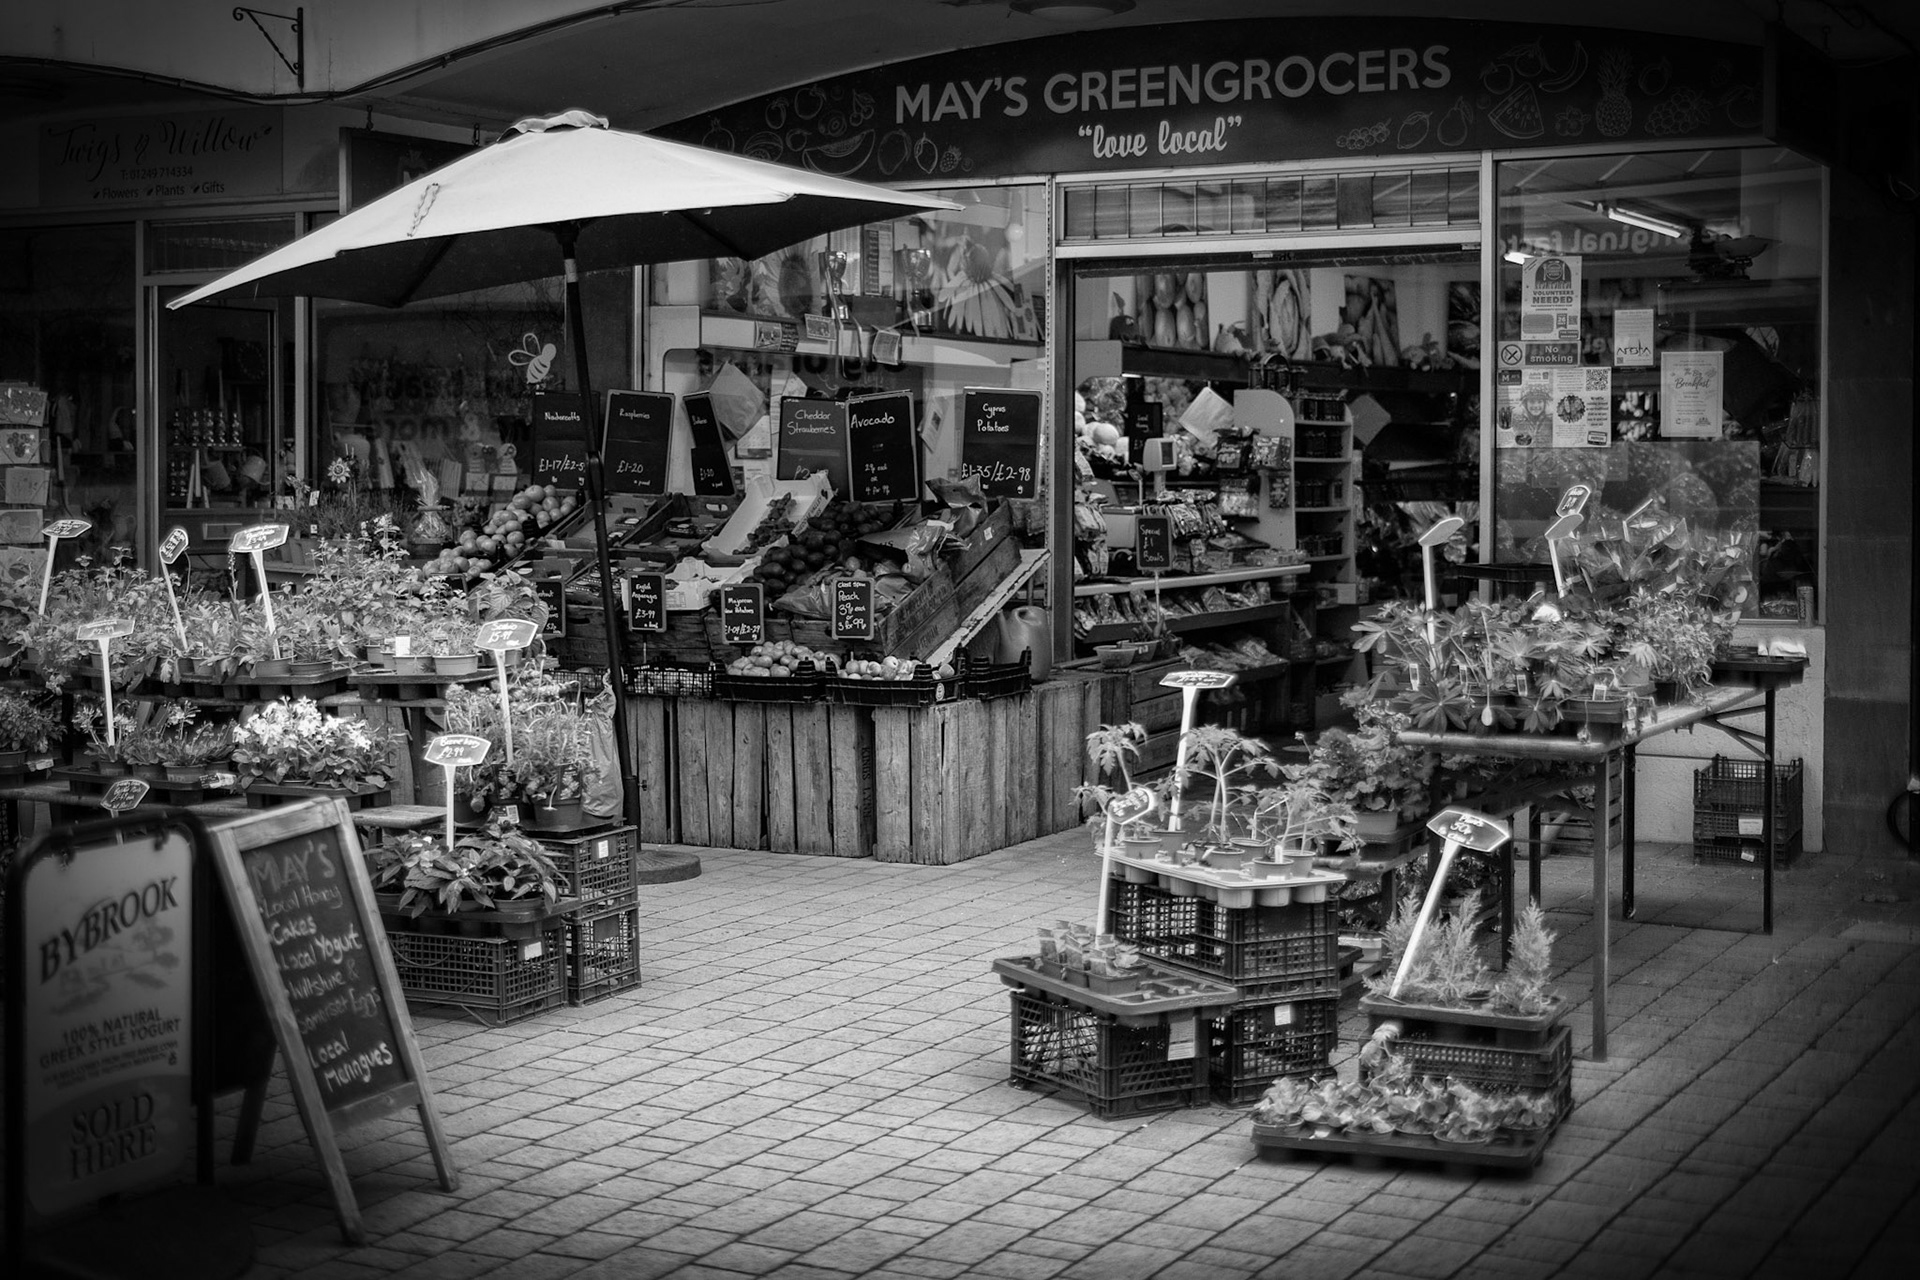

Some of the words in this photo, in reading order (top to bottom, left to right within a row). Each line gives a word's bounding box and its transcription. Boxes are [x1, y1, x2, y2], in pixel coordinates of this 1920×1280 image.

[896, 76, 1028, 124] MAY'S
[1044, 45, 1451, 114] GREENGROCERS
[48, 123, 120, 182] Twigs
[156, 117, 272, 156] Willow
[160, 166, 193, 178] 714334
[103, 187, 138, 199] Flowers
[156, 185, 185, 196] Plants
[202, 182, 225, 194] Gifts
[1532, 296, 1573, 304] NEEDED
[1530, 354, 1574, 363] smoking
[1545, 345, 1559, 353] No
[1674, 376, 1710, 390] Breakfast
[794, 409, 832, 421] Cheddar
[850, 412, 896, 429] Avocado
[982, 403, 1006, 419] Cyprus
[786, 421, 837, 436] Strawberries
[977, 419, 1010, 433] Potatoes
[538, 454, 586, 473] £1-17/£2-5
[616, 460, 644, 474] £1-20
[838, 590, 860, 602] Peach
[252, 839, 337, 893] MAY'S
[263, 890, 300, 919] Local
[39, 876, 178, 985] BYBROOK
[271, 915, 317, 945] Cakes
[280, 943, 317, 970] Local
[348, 987, 381, 1018] Eggs
[62, 1022, 99, 1044] 100%
[102, 1007, 161, 1033] NATURAL
[40, 1045, 85, 1069] GREEK
[89, 1033, 126, 1054] STYLE
[129, 1018, 181, 1042] YOGURT
[307, 1029, 350, 1069] Local
[71, 1092, 154, 1144] SOLD
[70, 1125, 157, 1181] HERE
